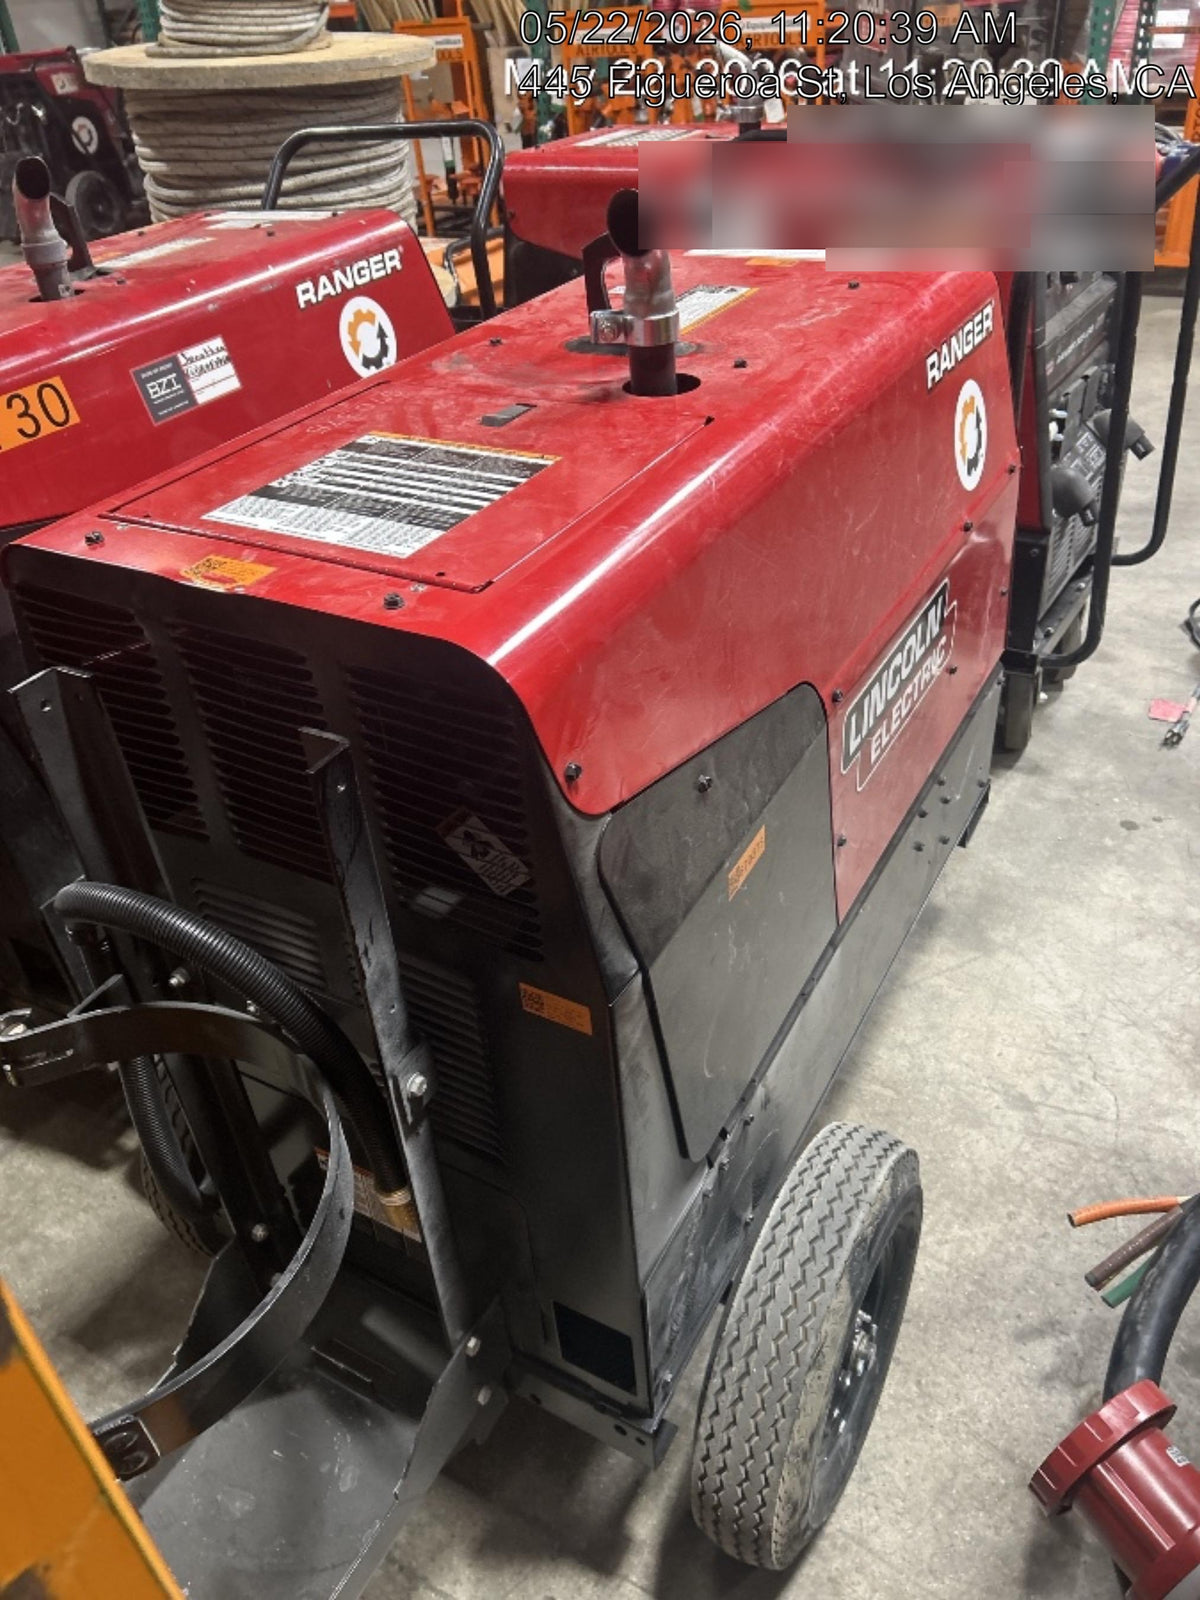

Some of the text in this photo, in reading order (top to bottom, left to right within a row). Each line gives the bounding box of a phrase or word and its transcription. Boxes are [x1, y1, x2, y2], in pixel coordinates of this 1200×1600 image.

[296, 246, 403, 309] RANGER
[925, 301, 994, 391] RANGER
[6, 382, 70, 439] 30
[849, 594, 944, 757] LINCOLN
[870, 634, 947, 765] ELECTRIC
